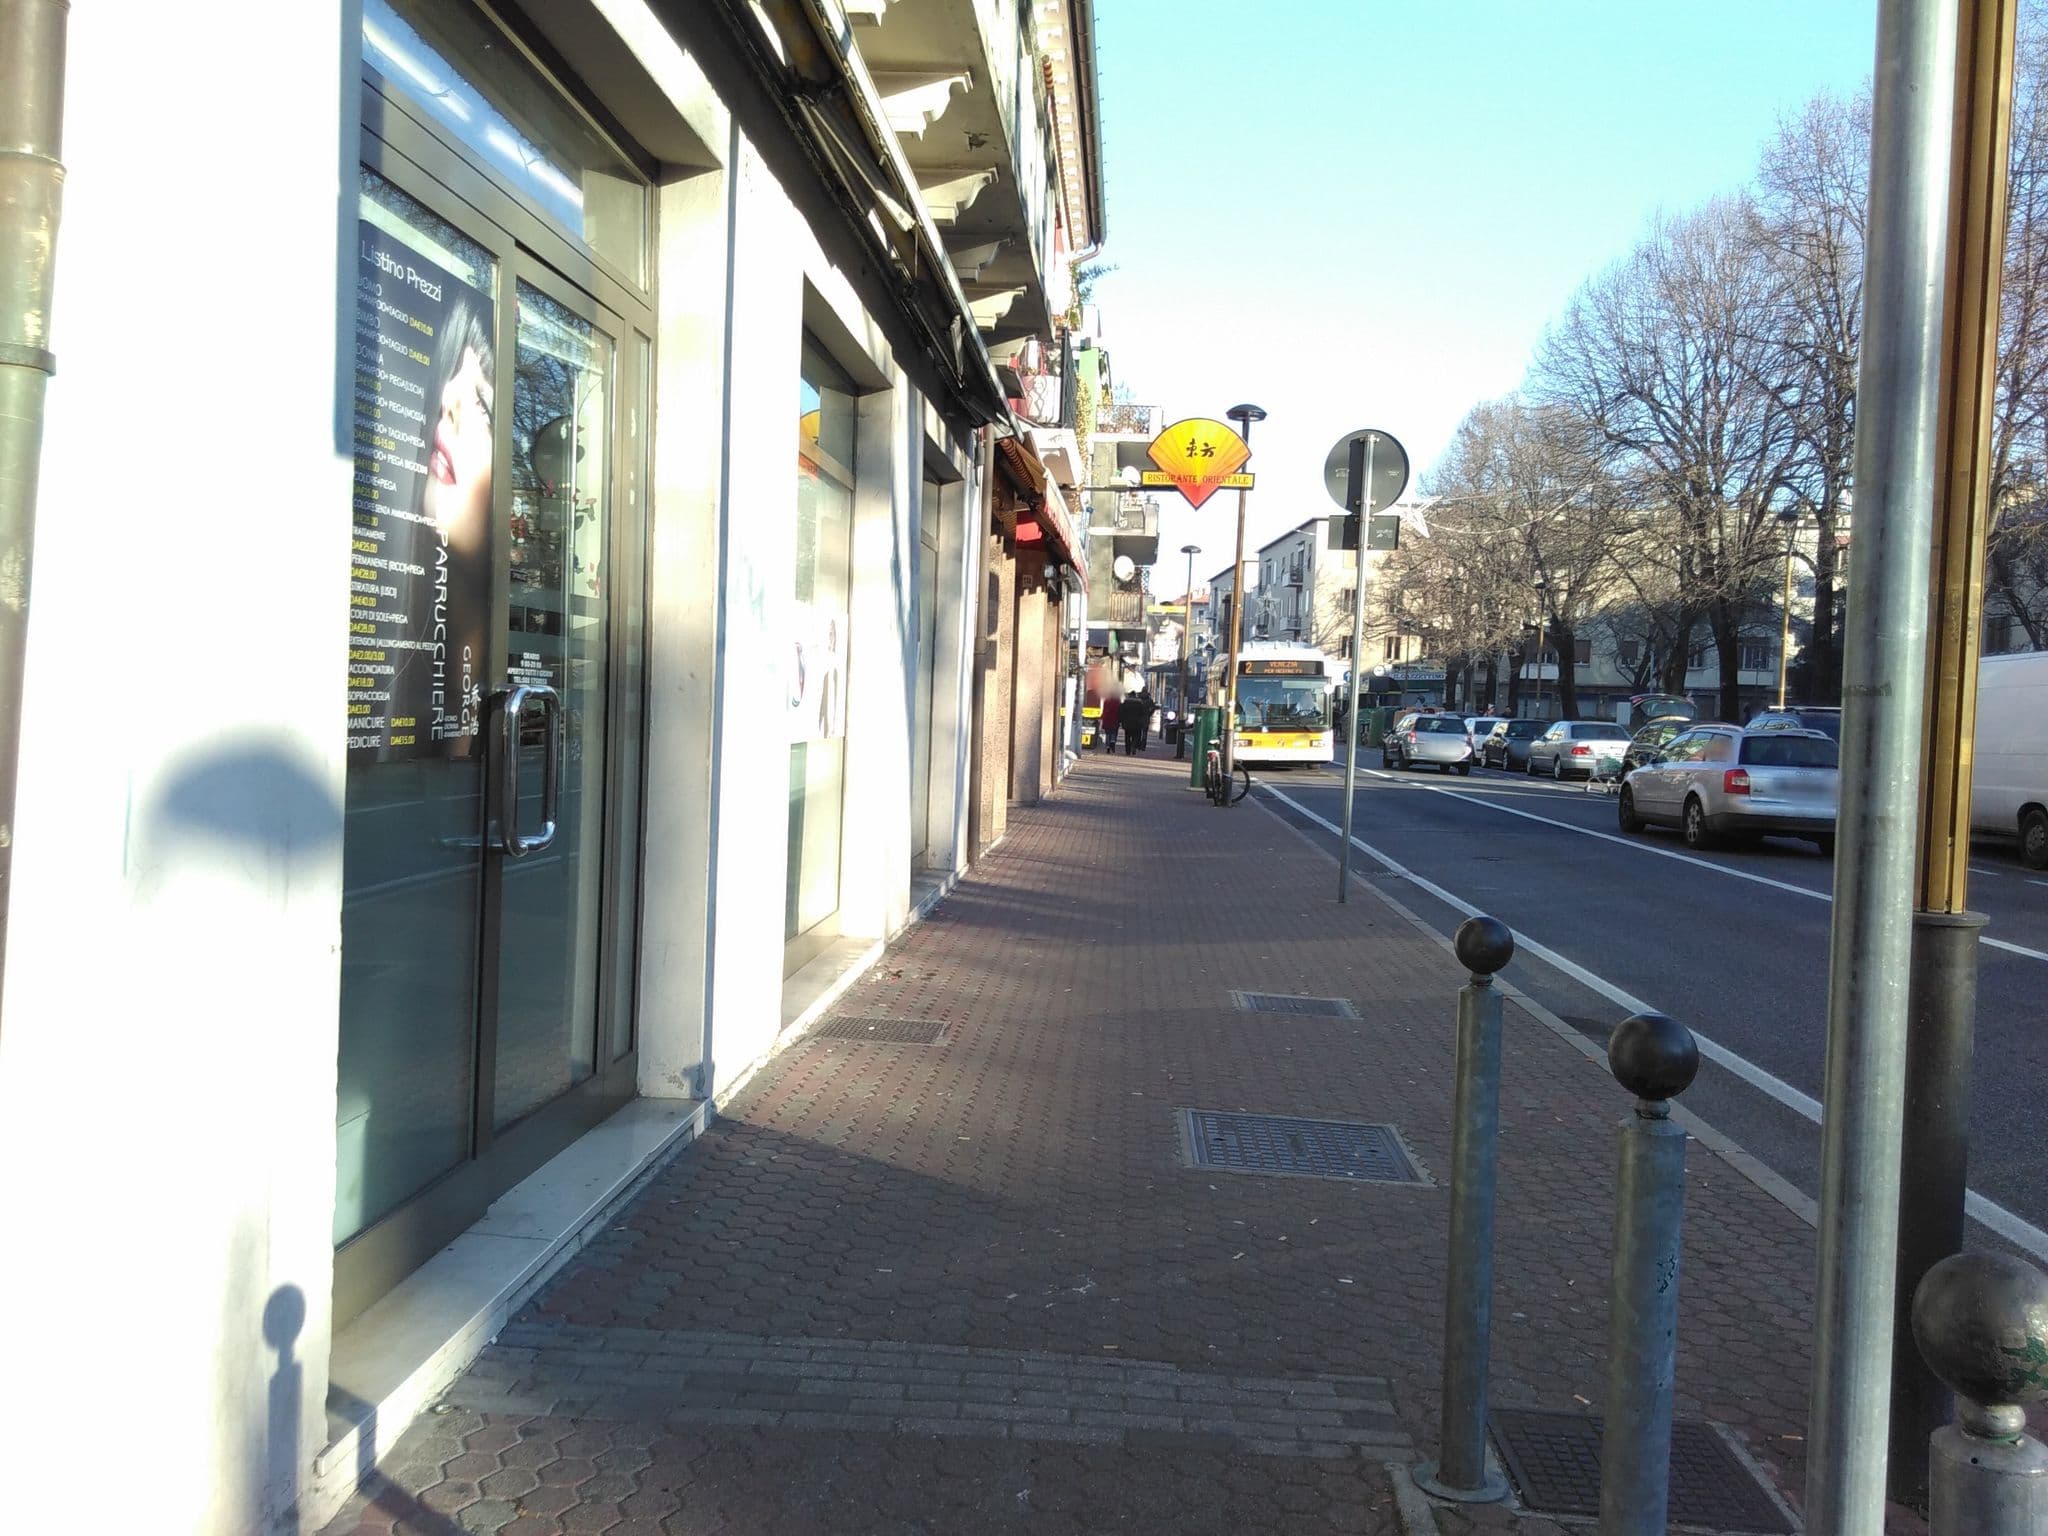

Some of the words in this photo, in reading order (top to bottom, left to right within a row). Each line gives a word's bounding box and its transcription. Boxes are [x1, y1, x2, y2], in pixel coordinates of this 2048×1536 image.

[360, 240, 404, 280] Listino
[407, 267, 442, 302] Prezzi
[1148, 473, 1198, 484] RISTORANTE
[1202, 474, 1249, 485] ORIENTALE
[431, 526, 449, 741] PARRUCCHIERE
[1245, 662, 1252, 674] 2
[461, 645, 472, 736] GEORGE
[346, 735, 381, 749] PEDICURE
